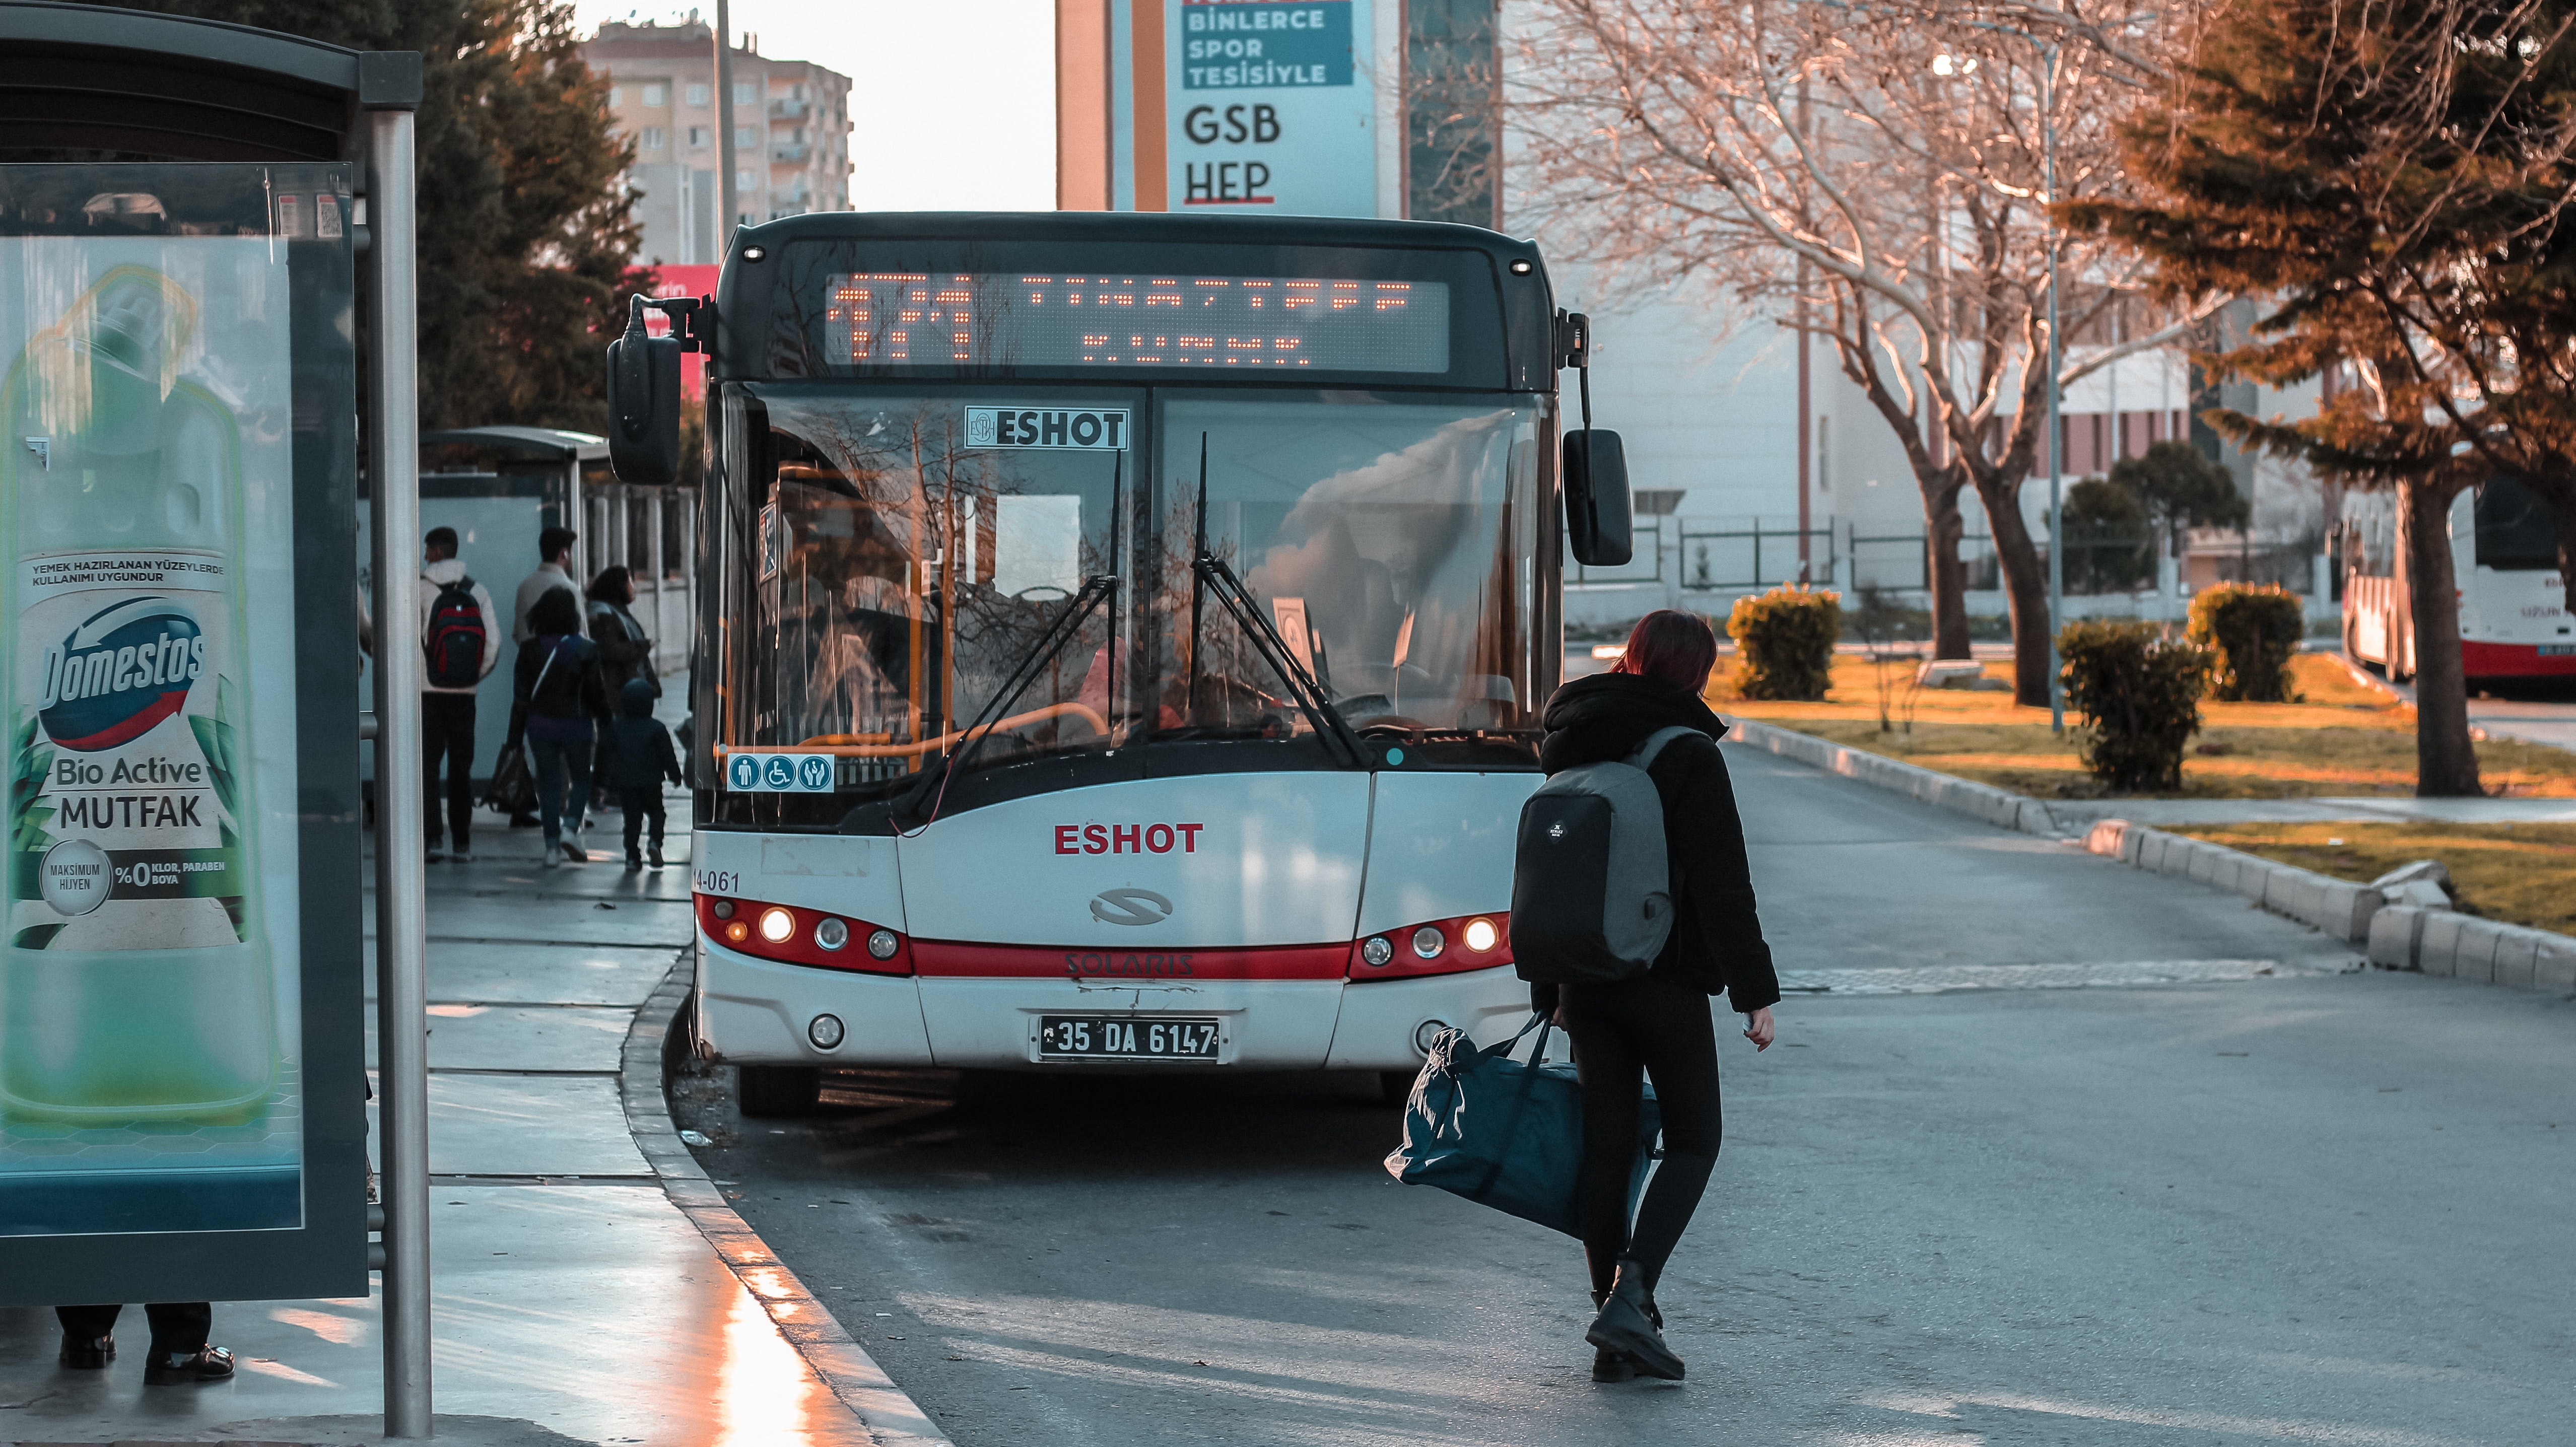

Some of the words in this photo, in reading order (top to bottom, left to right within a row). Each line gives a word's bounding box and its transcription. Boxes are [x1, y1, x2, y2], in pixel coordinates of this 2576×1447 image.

[1188, 7, 1325, 30] BİNLERCE
[1189, 38, 1263, 60] SPOR
[1189, 59, 1326, 86] TESİSİYLE
[1184, 104, 1281, 145] GSB
[1186, 161, 1270, 202] HEP
[996, 410, 1124, 447] ESHOT
[32, 562, 71, 575] YEMEK
[74, 560, 152, 572] HAZIRLANAN
[155, 559, 225, 575] YÜZEYLERDE
[33, 573, 95, 587] KULLANIMI
[97, 572, 164, 582] UYGUNDUR
[44, 632, 204, 707] Domestos
[56, 759, 103, 785] Bio
[110, 757, 201, 784] Active
[60, 795, 202, 829] MUTFAK
[1054, 823, 1204, 855] ESHOT
[50, 862, 100, 876] MAKSİMUM
[115, 862, 151, 887] %0
[152, 863, 180, 874] KLOR,
[182, 861, 225, 872] PARABEN
[152, 875, 179, 885] BOYA
[693, 868, 739, 893] 14-061
[59, 877, 90, 890] HİJYEN
[1064, 953, 1193, 976] SOLARIS
[1058, 1022, 1090, 1051] 35
[1105, 1023, 1136, 1053] DA
[1149, 1024, 1215, 1054] 6147
